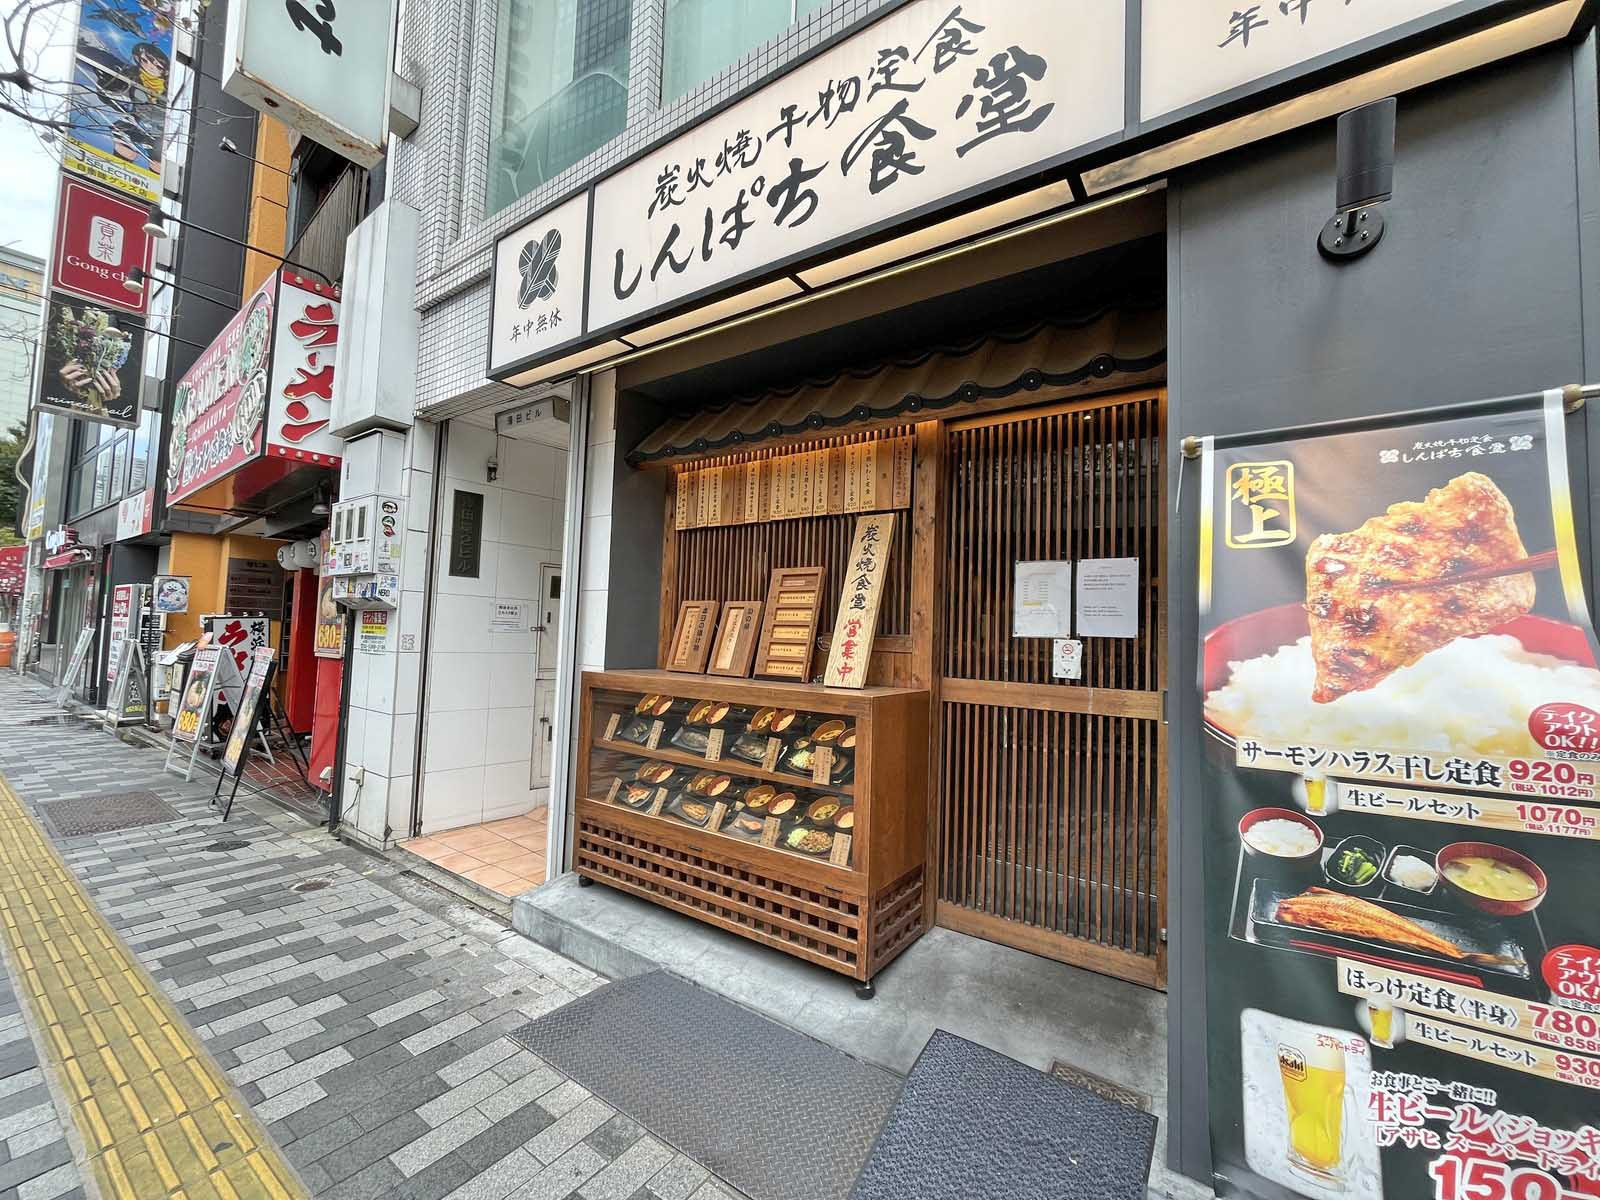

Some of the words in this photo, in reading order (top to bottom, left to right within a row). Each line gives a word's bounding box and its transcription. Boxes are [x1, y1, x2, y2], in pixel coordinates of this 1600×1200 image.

[646, 5, 986, 219] 炭火焼干物定食
[612, 45, 1056, 300] しんぱち食堂
[67, 255, 109, 279] Gong
[112, 270, 129, 284] ch
[510, 309, 562, 342] 年中無休
[1232, 467, 1290, 543] 極上
[850, 524, 881, 611] 炭火焼食堂
[836, 618, 864, 681] 営業中
[1541, 709, 1595, 724] テイク
[1544, 721, 1597, 736] アウト
[1544, 734, 1599, 749] OK!!
[1242, 741, 1503, 788] サーモンハラス干し定食
[1508, 760, 1595, 785] 920円
[1347, 788, 1480, 820] 生ビールセット
[1516, 804, 1596, 827] 1070円
[1556, 952, 1600, 971] テイ
[1558, 967, 1600, 984] アウ
[1528, 1004, 1600, 1038] 780
[1415, 1020, 1537, 1066] 生ビールセット
[1564, 1036, 1600, 1052] 858
[1371, 1073, 1496, 1104] お食事とご一緒に!!
